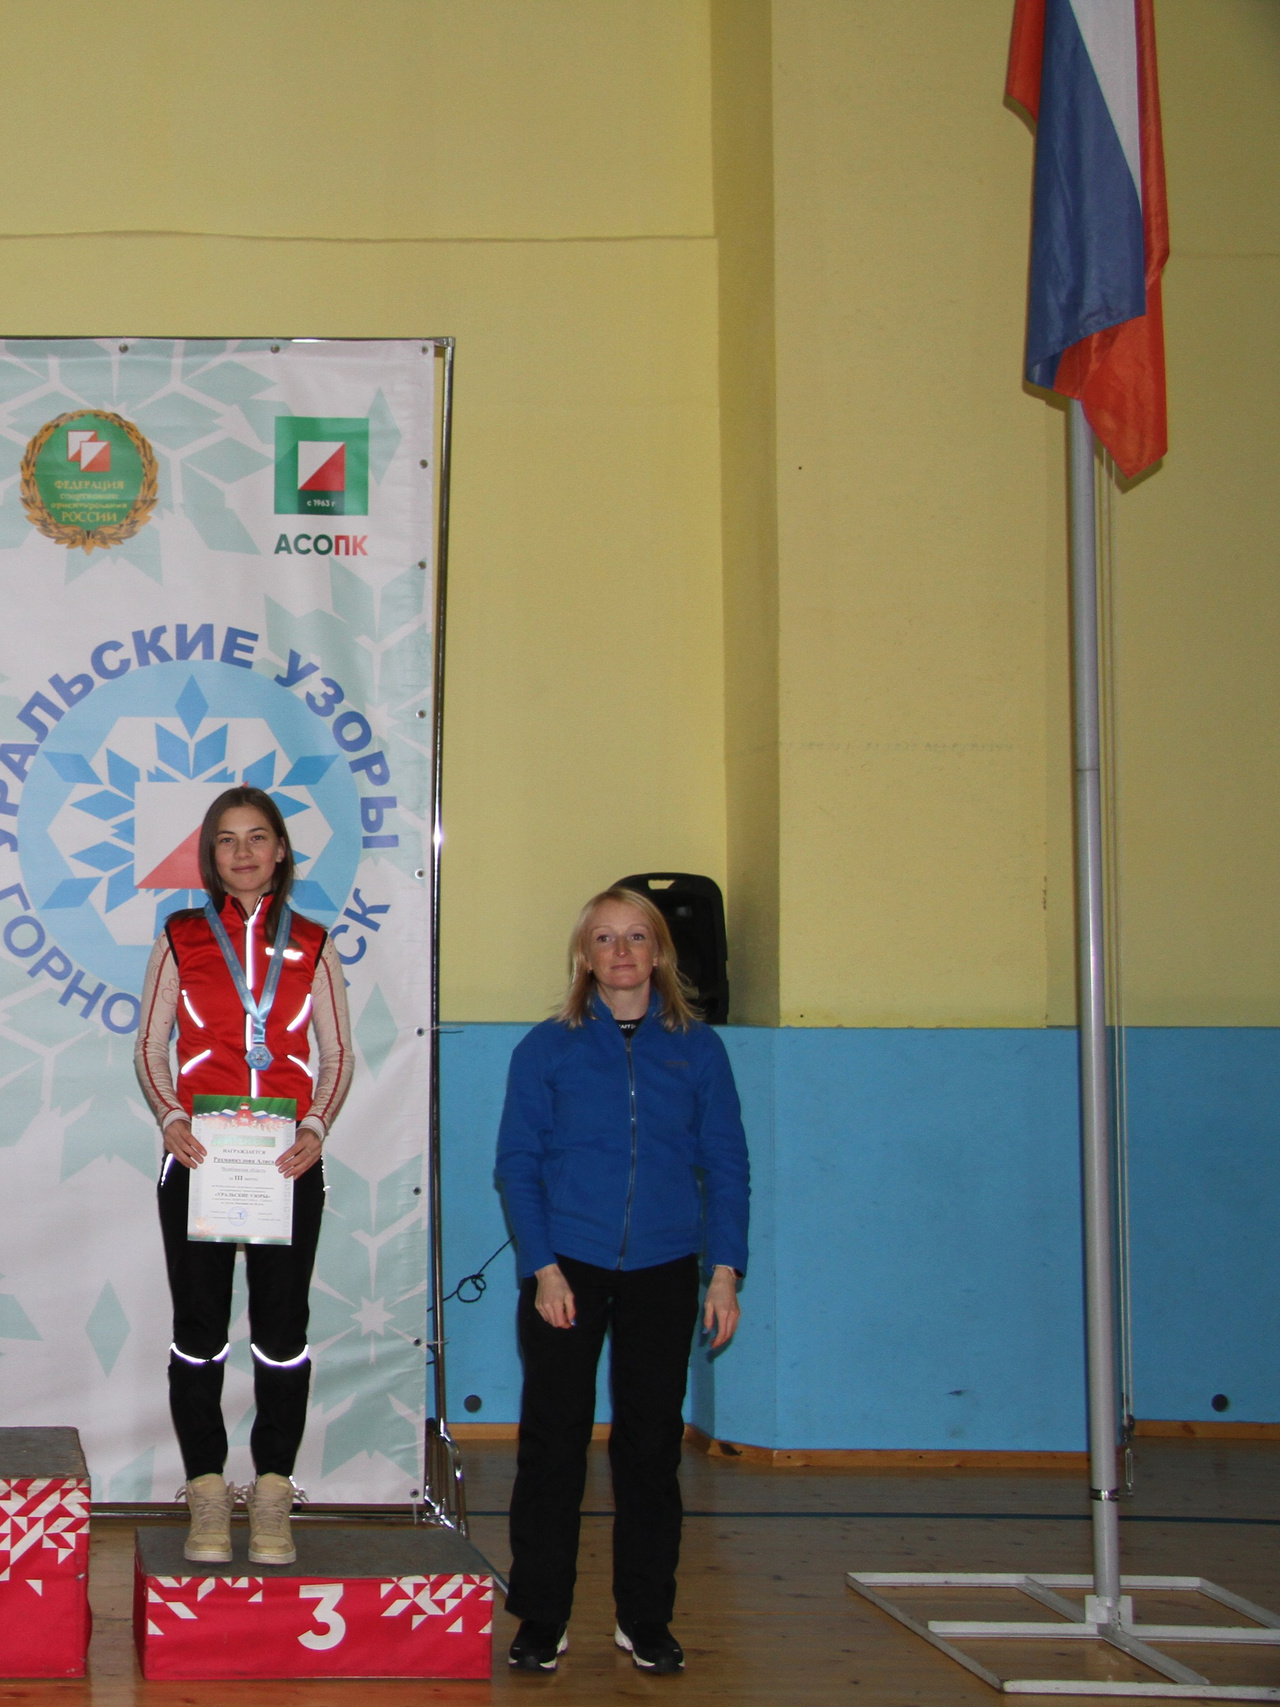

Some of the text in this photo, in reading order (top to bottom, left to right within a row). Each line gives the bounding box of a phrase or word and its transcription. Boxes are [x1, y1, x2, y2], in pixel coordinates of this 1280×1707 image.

[54, 480, 125, 491] ФЕДЕРАЦИЯ
[61, 511, 118, 522] РОССИИ
[274, 533, 368, 556] АСОПК
[274, 649, 399, 849] УЗОРЫ
[296, 1583, 347, 1652] 3
